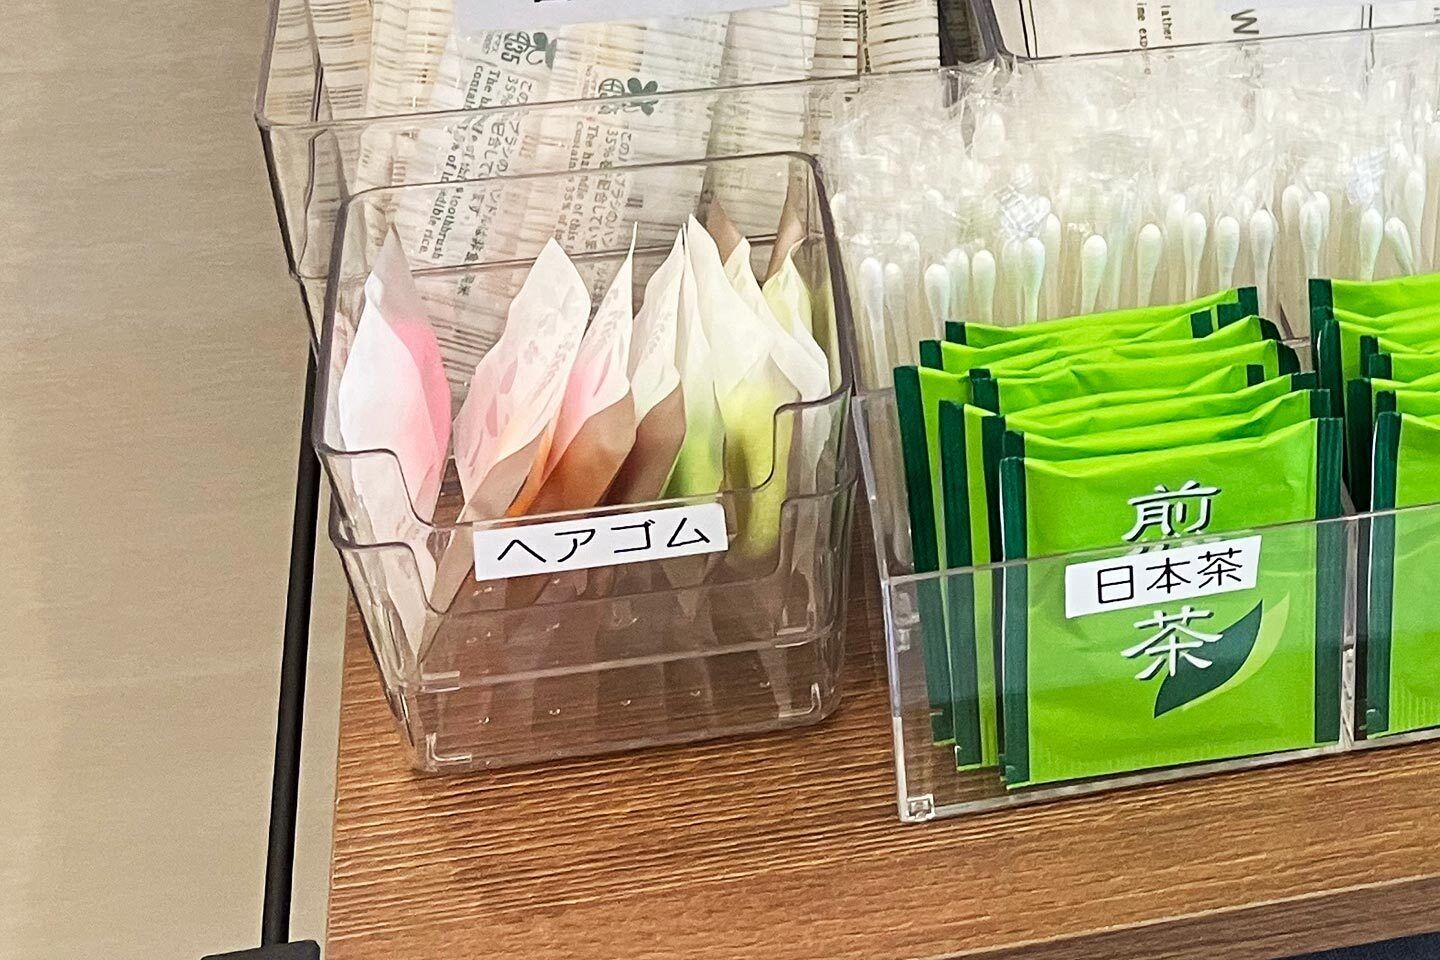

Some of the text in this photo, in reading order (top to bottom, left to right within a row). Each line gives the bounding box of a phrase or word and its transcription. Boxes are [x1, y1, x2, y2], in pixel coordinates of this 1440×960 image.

[496, 516, 711, 565] ヘアゴム
[1096, 547, 1244, 604] 日本茶
